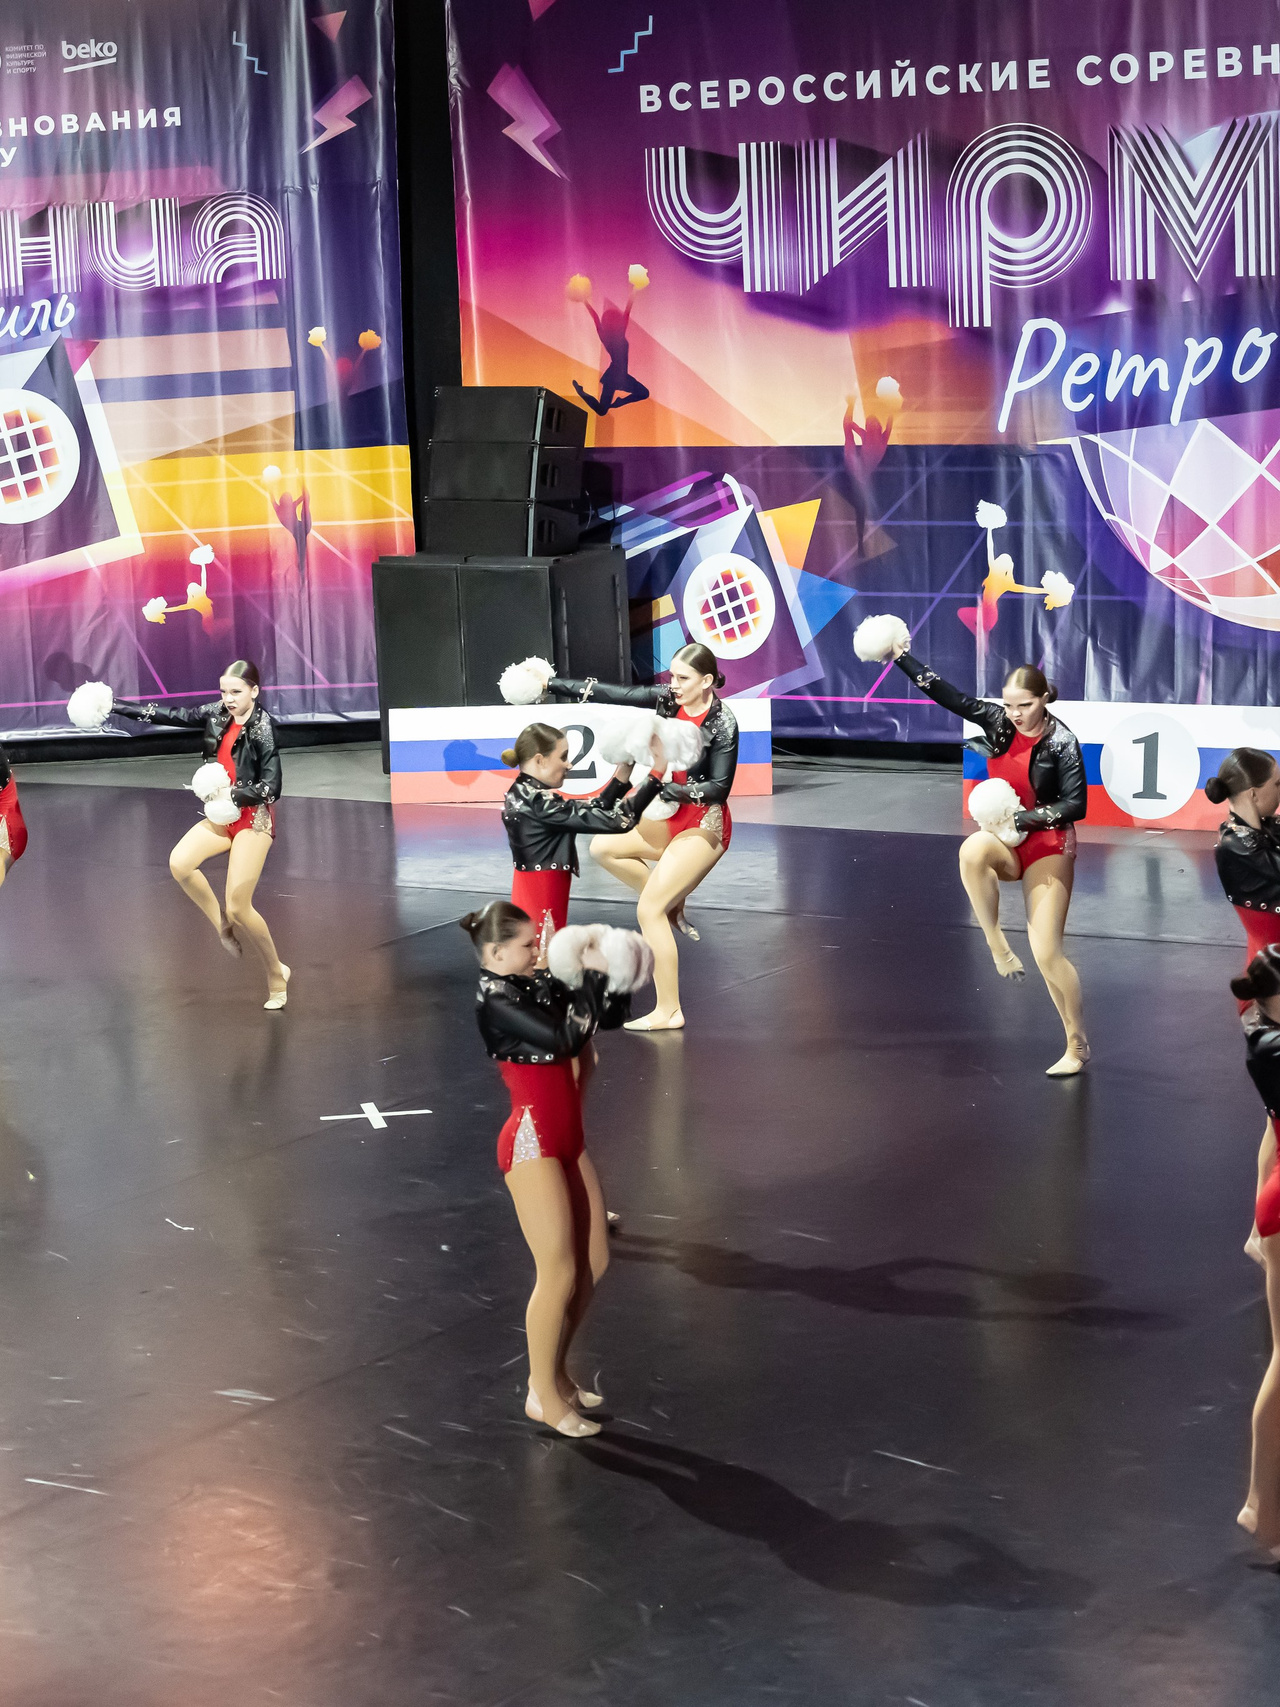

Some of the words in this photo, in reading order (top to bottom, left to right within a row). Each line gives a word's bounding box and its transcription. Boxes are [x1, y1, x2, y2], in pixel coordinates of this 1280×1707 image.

[5, 50, 47, 59] ФИЗИЧЕСКОЙ
[6, 59, 35, 67] КУЛЬТУРЕ
[61, 38, 118, 60] beko
[12, 66, 37, 74] СПОРТУ
[639, 58, 1051, 114] ВСЕРОССИЙСКИЕ
[1076, 43, 1280, 87] СОРЕВН
[997, 317, 1279, 433] Ретро
[560, 724, 597, 779] 2
[1132, 731, 1167, 800] 1
